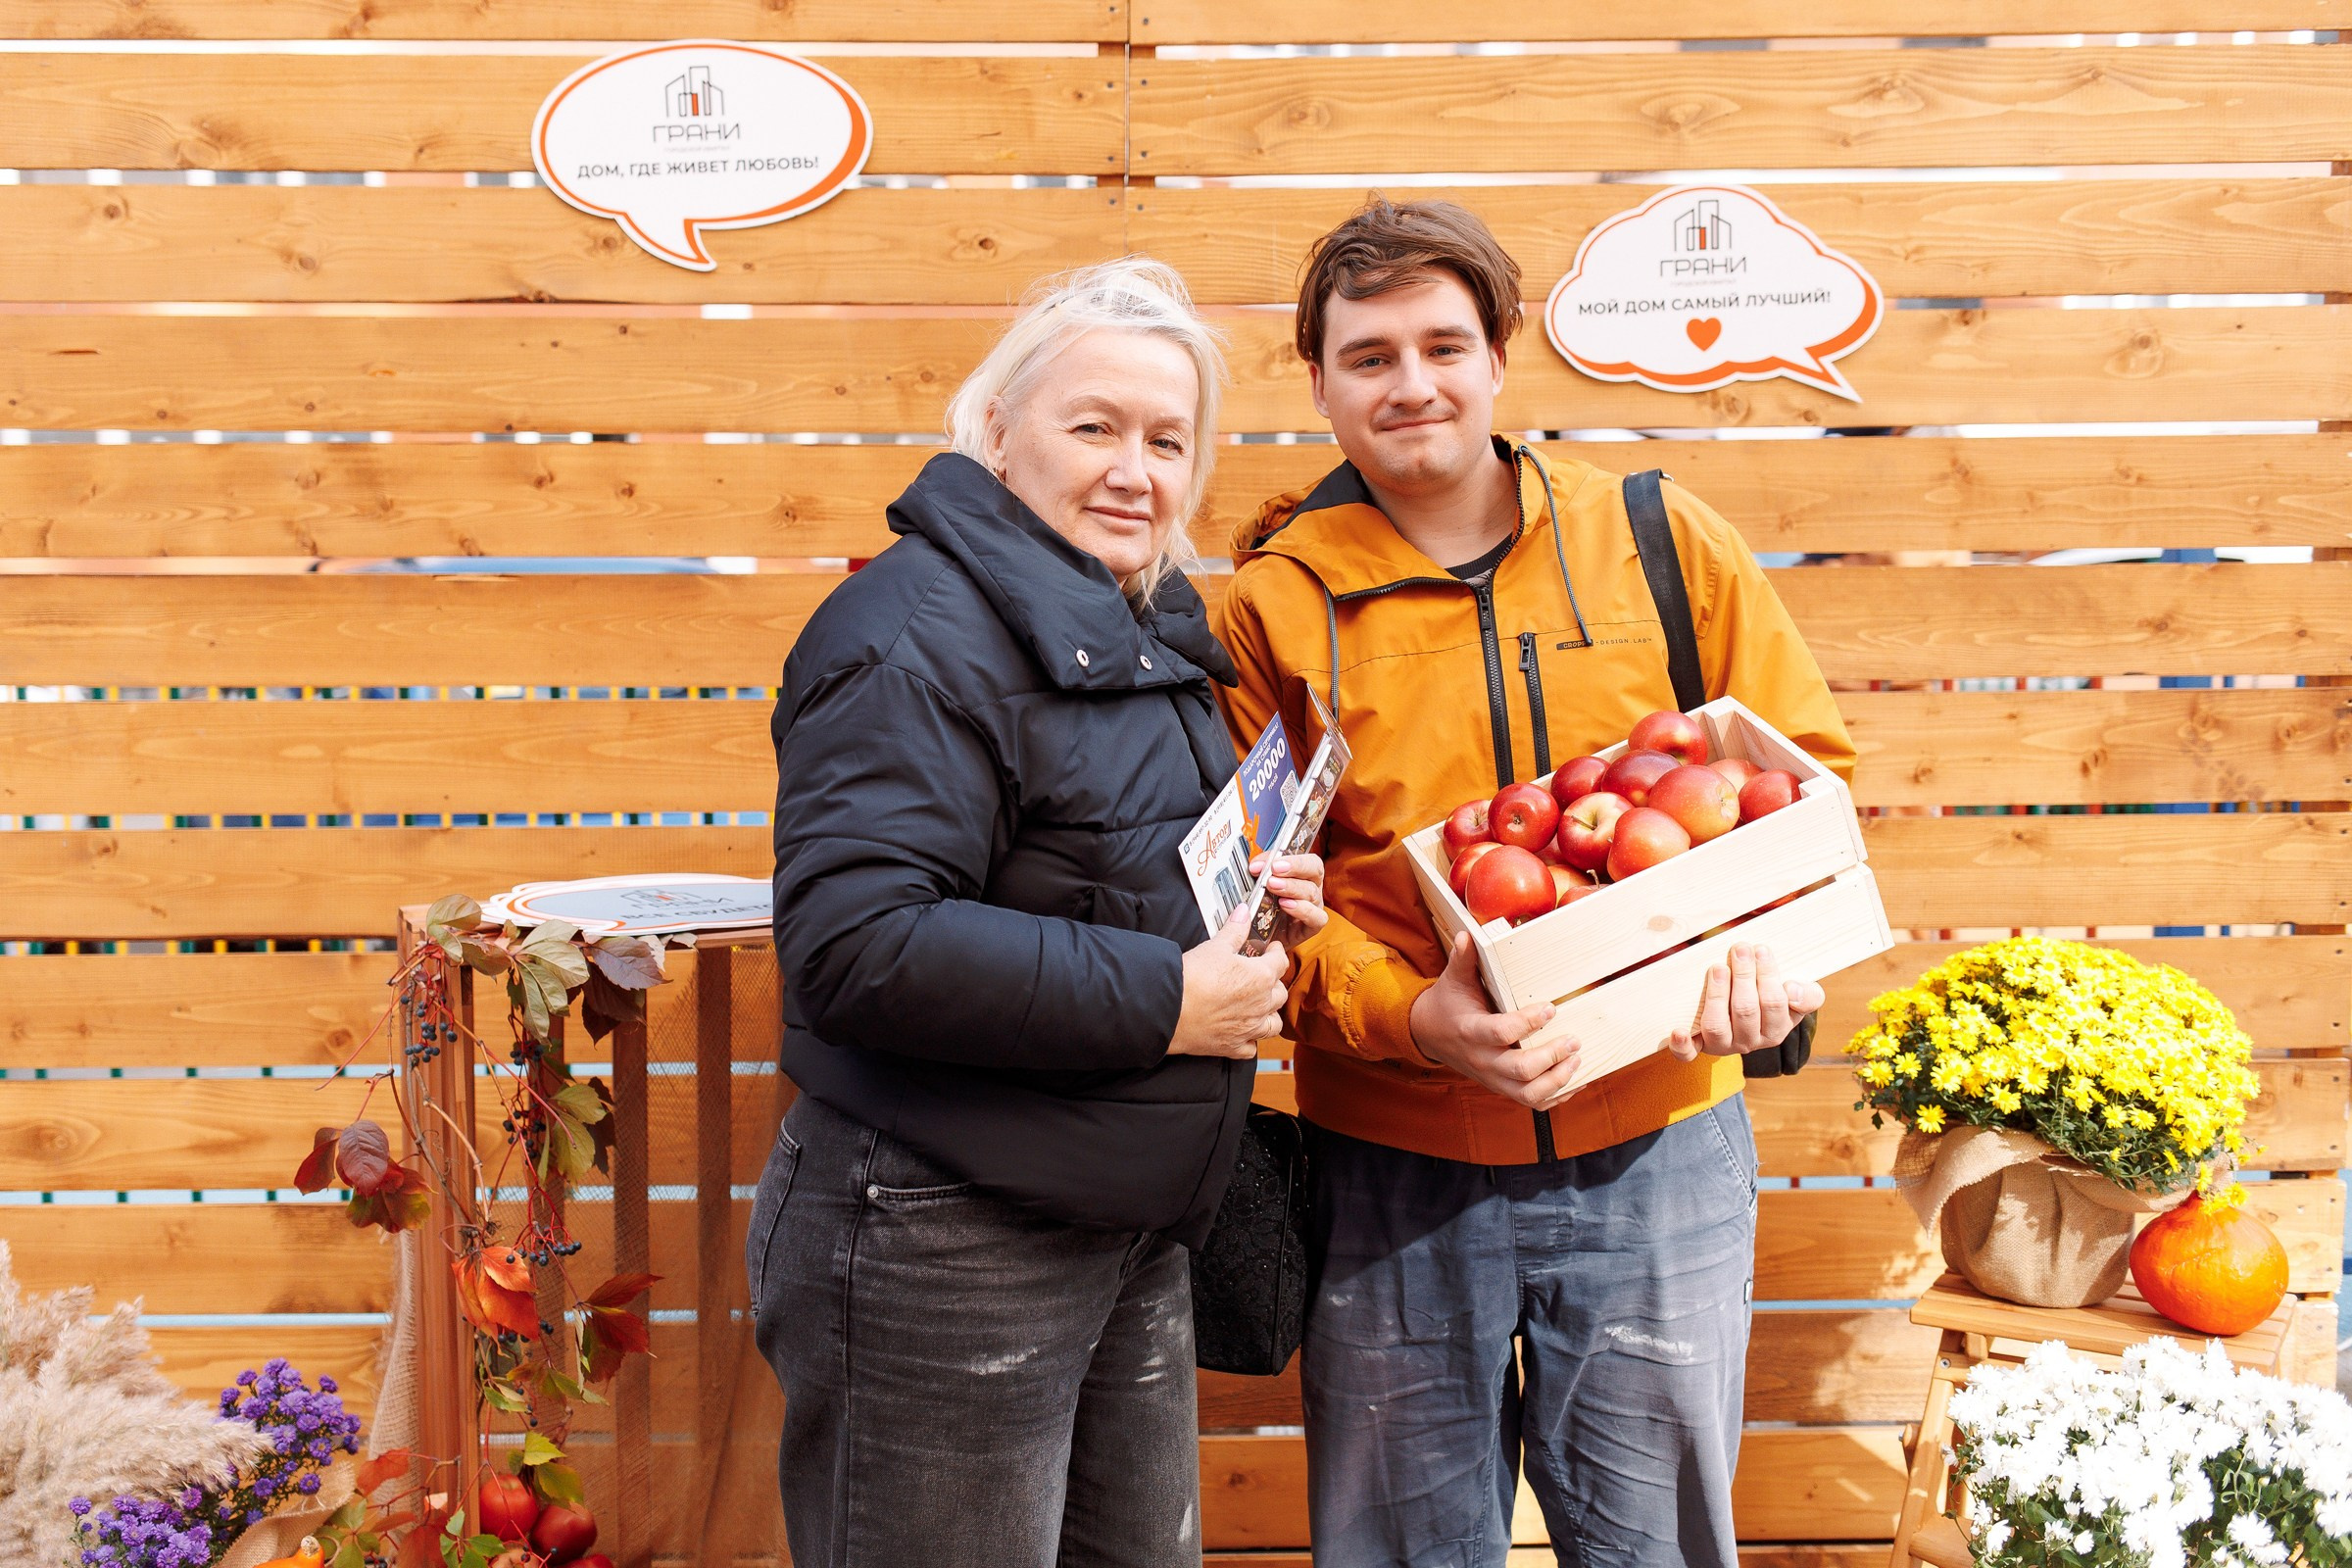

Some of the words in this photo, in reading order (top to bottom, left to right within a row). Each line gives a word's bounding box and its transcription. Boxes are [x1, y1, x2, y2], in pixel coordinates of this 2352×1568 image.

[652, 122, 741, 143] ГРАНИ
[577, 164, 624, 179] ДОМ,
[629, 162, 662, 178] ГДЕ
[666, 159, 729, 175] ЖИВЕТ
[734, 155, 819, 172] ЛЮБОВЬ!
[1659, 256, 1747, 277] ГРАНИ
[1578, 298, 1619, 317] МОЙ
[1624, 299, 1666, 316] ДОМ
[1671, 292, 1740, 312] САМЫЙ
[1744, 288, 1832, 308] ЛУЧШИЙ!
[1249, 737, 1286, 803] 20000
[674, 903, 772, 917] СБУДЕТС
